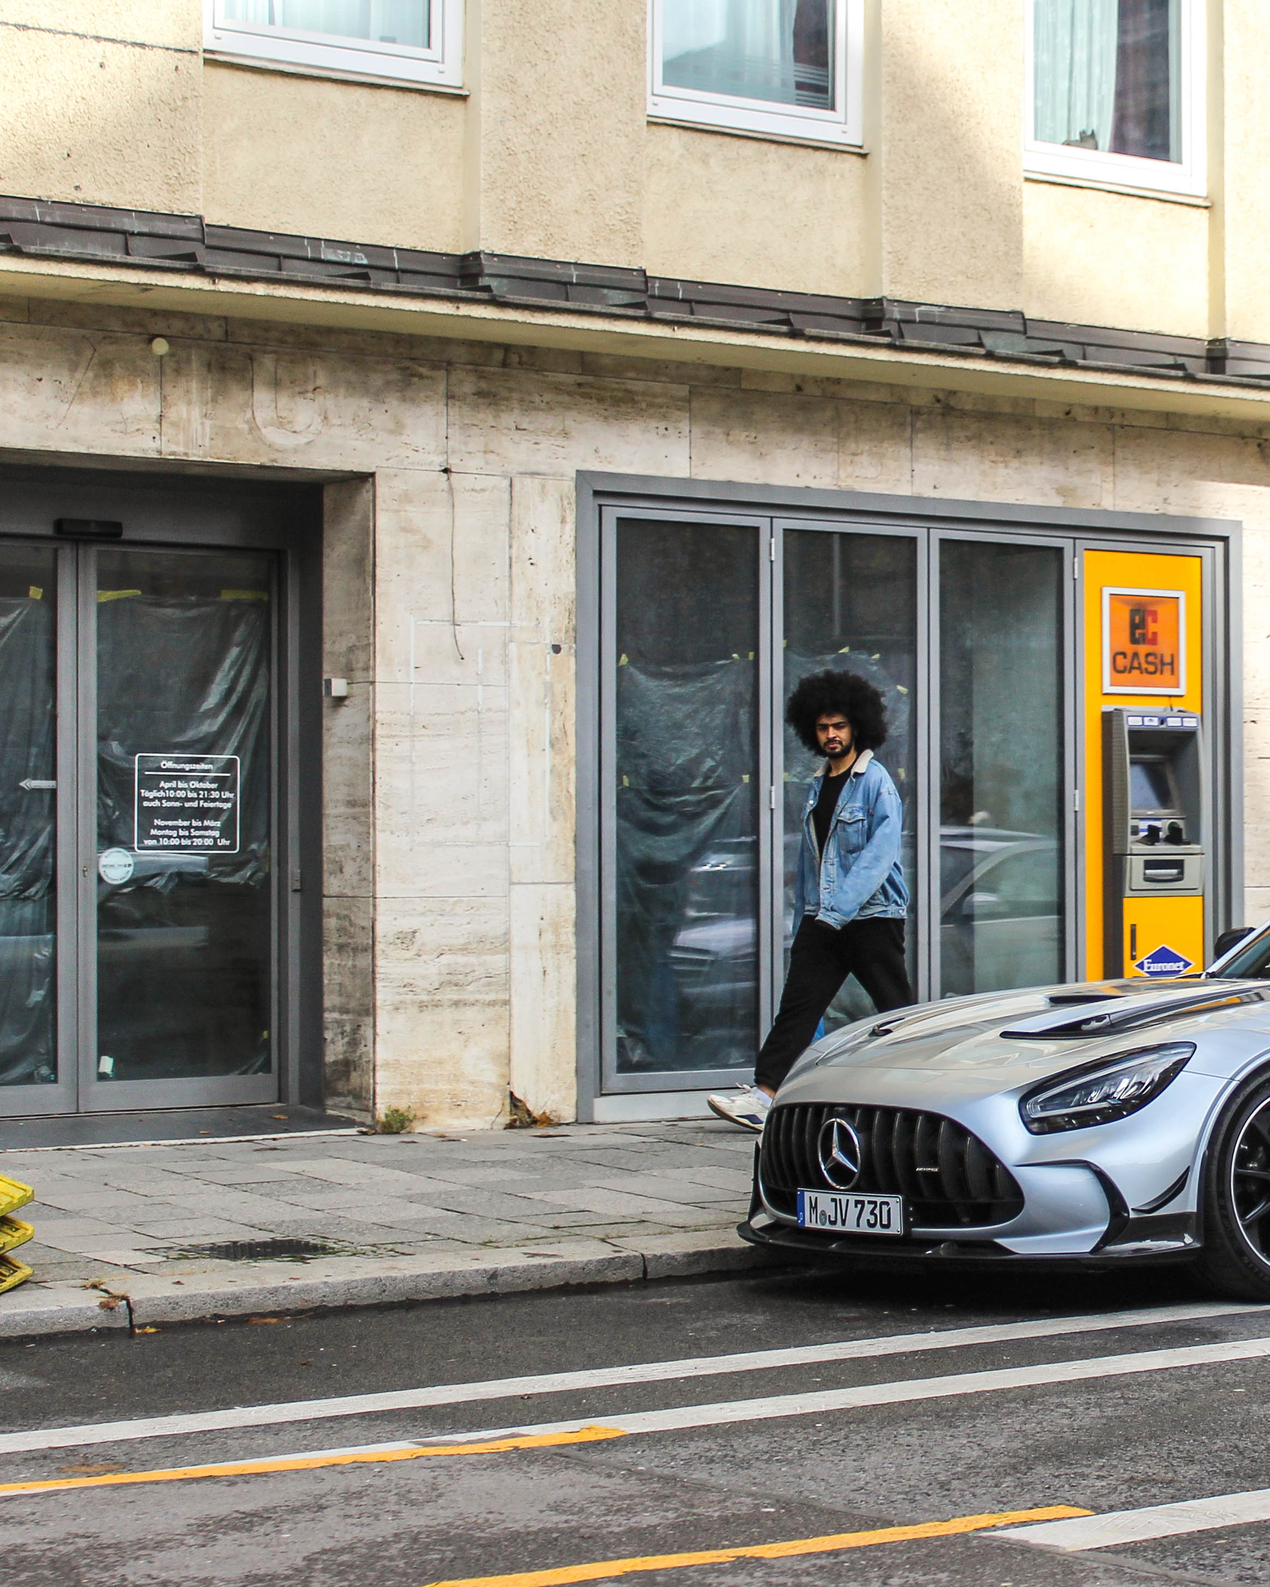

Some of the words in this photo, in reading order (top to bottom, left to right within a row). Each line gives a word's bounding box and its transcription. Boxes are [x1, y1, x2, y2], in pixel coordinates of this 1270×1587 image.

[1113, 652, 1175, 676] CASH
[160, 761, 213, 771] Öffnungszeiten
[159, 781, 176, 789] April
[187, 790, 197, 798] bis
[150, 829, 177, 837] Montag
[191, 829, 220, 837] Samstag
[828, 1198, 849, 1226] JV
[855, 1200, 891, 1229] 730
